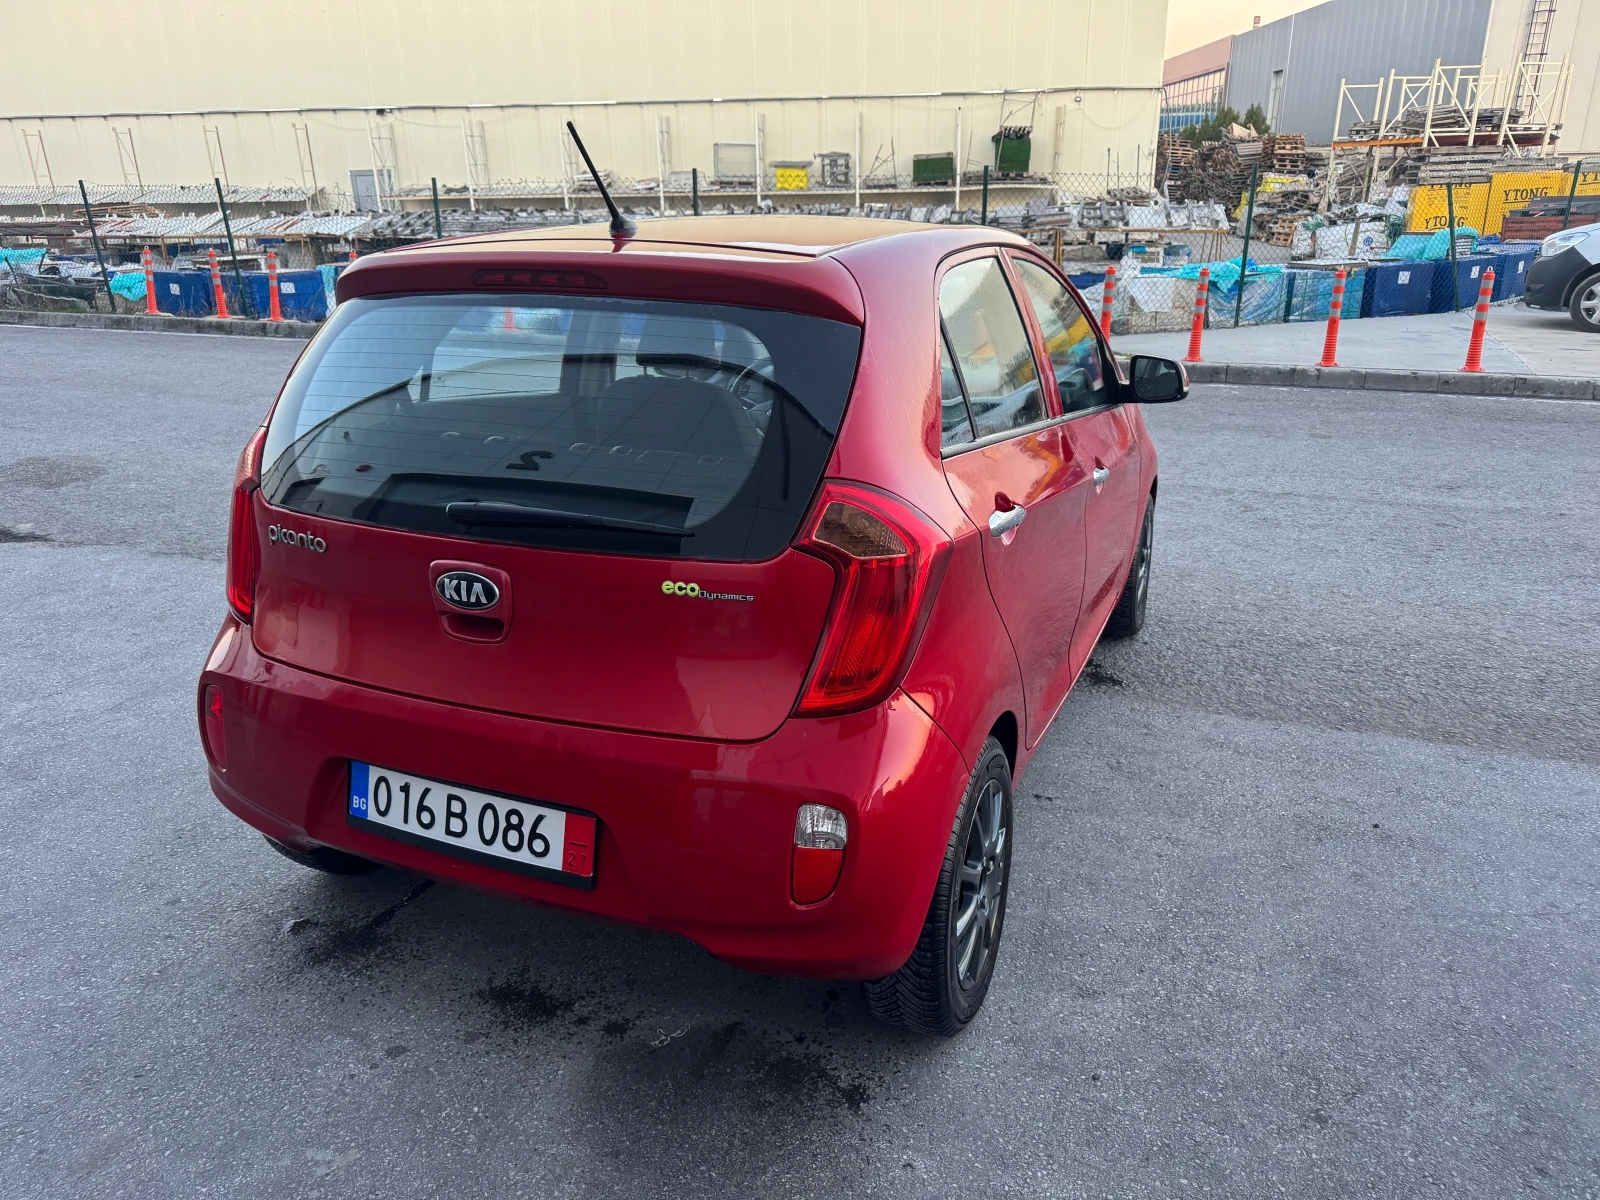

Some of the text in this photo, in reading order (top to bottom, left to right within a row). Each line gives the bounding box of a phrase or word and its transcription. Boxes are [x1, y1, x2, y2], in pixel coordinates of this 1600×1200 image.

[1503, 187, 1548, 201] YTONG
[1425, 216, 1465, 229] YTOG
[268, 523, 326, 553] picanto
[443, 578, 488, 604] KIA
[353, 795, 367, 810] BG
